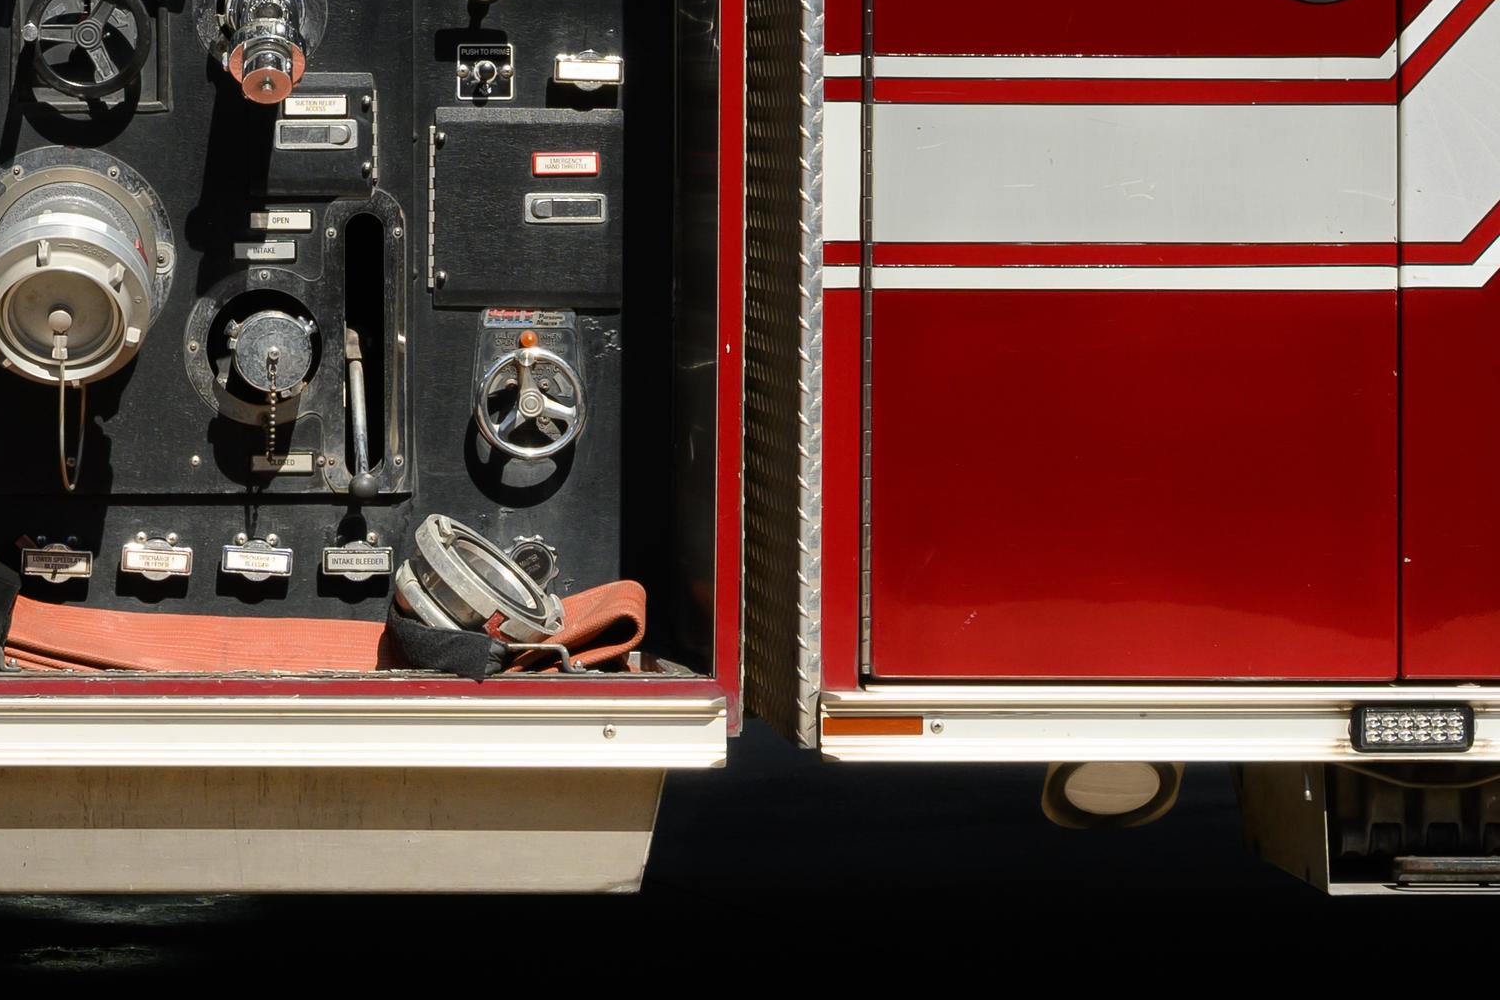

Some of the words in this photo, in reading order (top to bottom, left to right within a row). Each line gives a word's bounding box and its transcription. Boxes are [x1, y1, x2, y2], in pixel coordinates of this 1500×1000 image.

[461, 48, 480, 56] PUSH
[480, 48, 489, 56] TO
[489, 48, 510, 56] PRIME
[139, 554, 170, 562] DISCHARGE
[355, 558, 384, 566] BLEEDER
